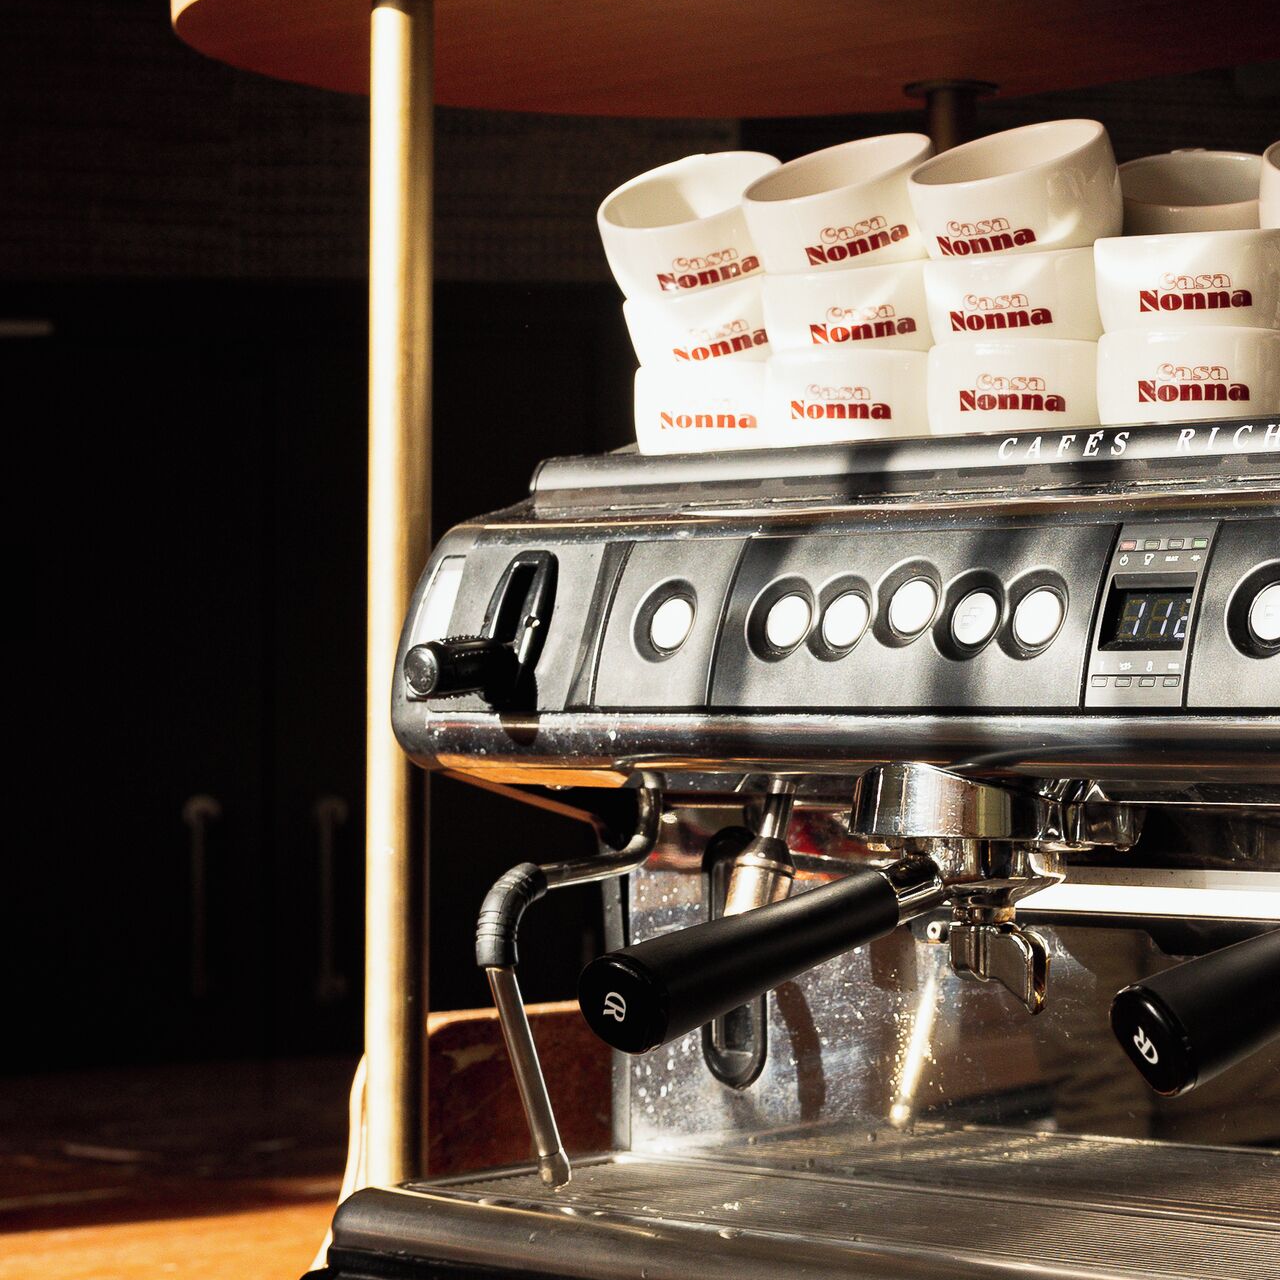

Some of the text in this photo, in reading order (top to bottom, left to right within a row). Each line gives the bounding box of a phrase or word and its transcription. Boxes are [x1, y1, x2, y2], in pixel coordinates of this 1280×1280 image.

[820, 216, 888, 244] Casa
[946, 217, 1011, 238] Casa
[805, 223, 909, 266] Nonna
[935, 225, 1036, 257] Nonna
[672, 248, 739, 273] Casa
[657, 255, 760, 291] Nonna
[1159, 272, 1231, 291] Casa
[963, 291, 1029, 311] Casa
[1139, 289, 1253, 313] Nonna
[810, 317, 917, 345] Nonna
[949, 307, 1053, 332] Nonna
[673, 328, 768, 362] Nonna
[976, 373, 1046, 392] Casa
[1156, 363, 1229, 383] Casa
[805, 384, 871, 401] Casa
[959, 389, 1066, 412] Nonna
[1138, 380, 1251, 403] Nonna
[660, 411, 758, 430] Nonna
[790, 400, 892, 420] Nonna
[998, 430, 1130, 458] CAFÉS
